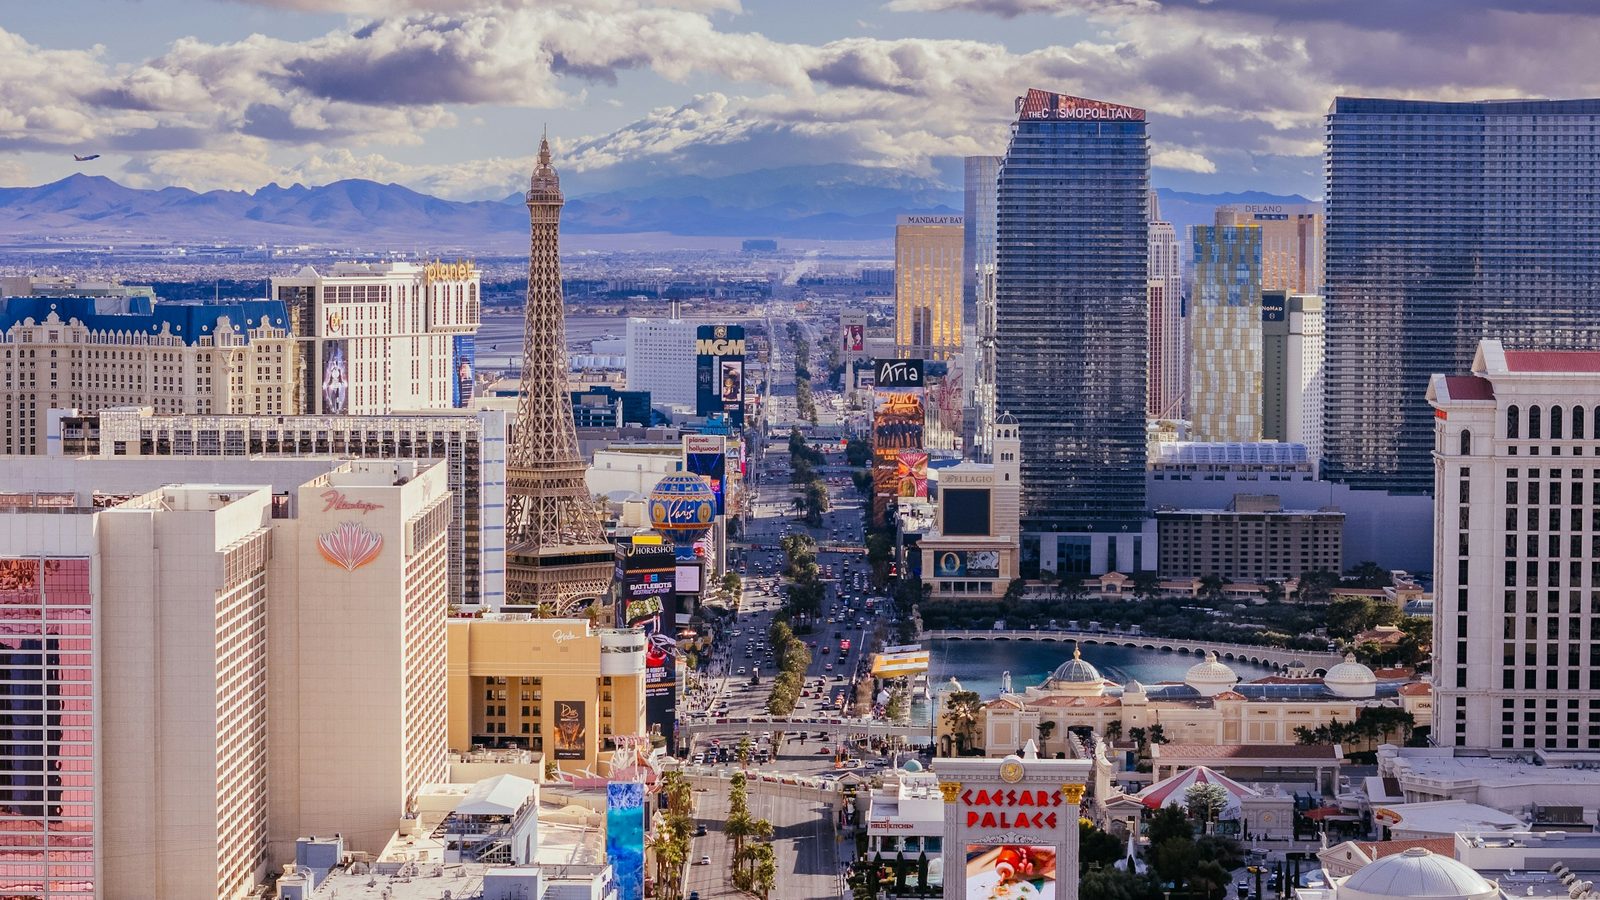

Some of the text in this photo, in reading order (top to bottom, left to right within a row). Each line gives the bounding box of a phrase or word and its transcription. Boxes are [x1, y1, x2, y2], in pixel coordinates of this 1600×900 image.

[1041, 108, 1132, 119] CSMOPOLITAN
[1245, 205, 1282, 213] DELANO
[908, 216, 963, 224] MANDALAY BAY
[427, 259, 474, 287] planet
[696, 338, 746, 356] MGM
[880, 362, 918, 383] Aria
[688, 436, 709, 444] planet
[688, 445, 720, 453] hollywood
[942, 475, 993, 483] BELLAGIO
[320, 490, 385, 515] Flamingo
[668, 497, 695, 528] Paris
[635, 547, 675, 555] HORSESHOE
[630, 582, 672, 591] BATTLEBOTS
[961, 789, 1063, 808] CAESARS
[966, 811, 1057, 829] PALACE
